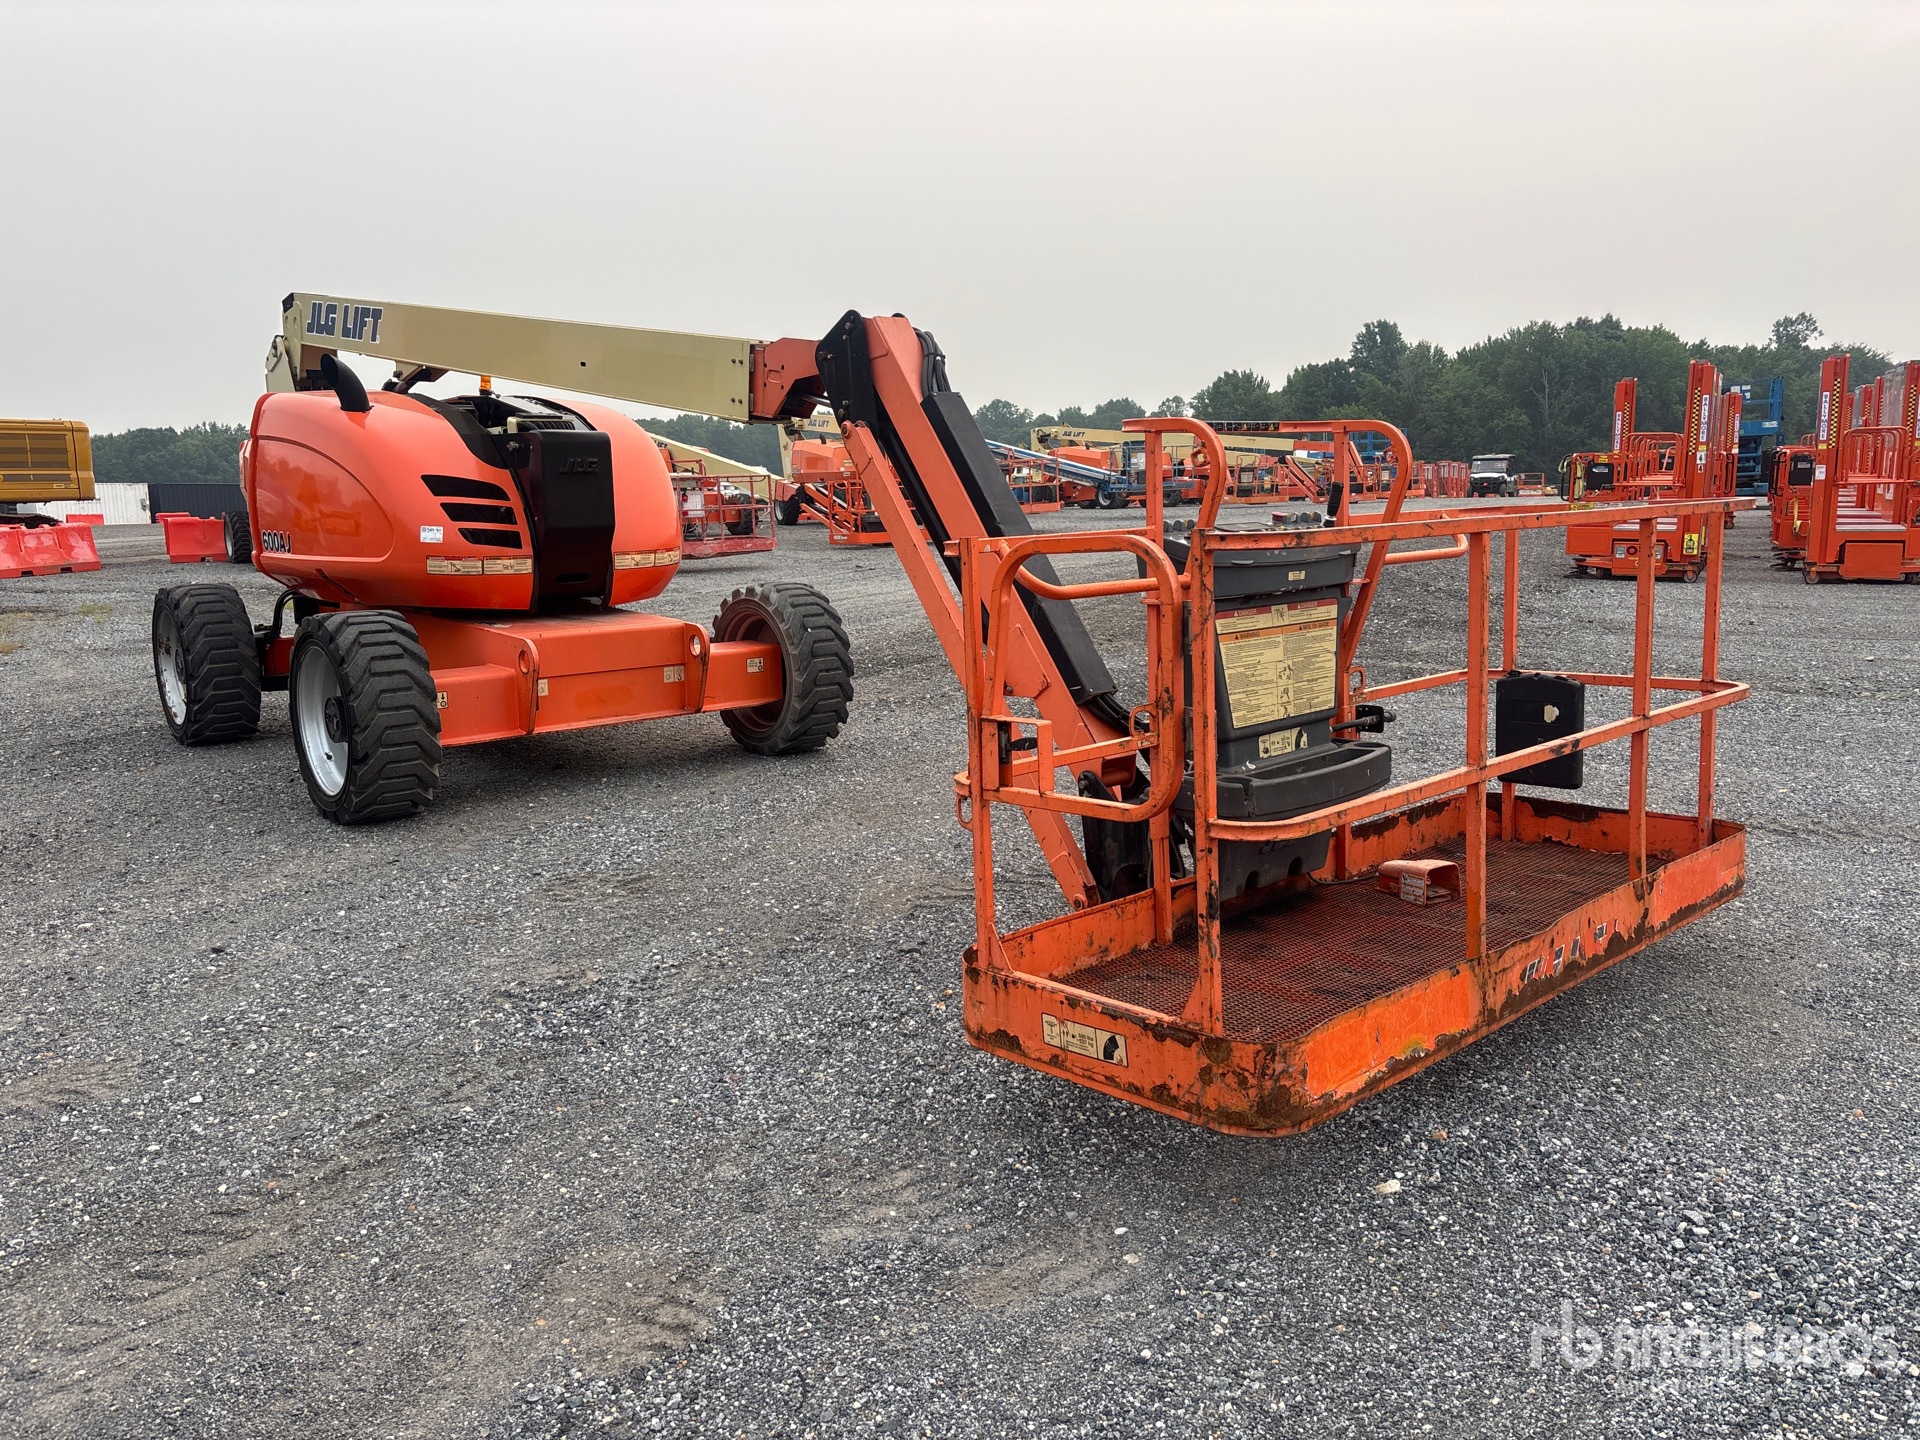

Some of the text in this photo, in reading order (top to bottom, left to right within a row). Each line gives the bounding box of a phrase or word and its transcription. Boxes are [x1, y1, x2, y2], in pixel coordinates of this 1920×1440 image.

[306, 301, 383, 344] JLG LIFT
[817, 420, 830, 428] LIFT
[1701, 396, 1709, 441] BALLYMORE
[1820, 393, 1829, 439] BALLYMORE
[559, 457, 599, 474] JLG
[1238, 608, 1257, 616] DANGER
[1239, 632, 1260, 640] WARNING
